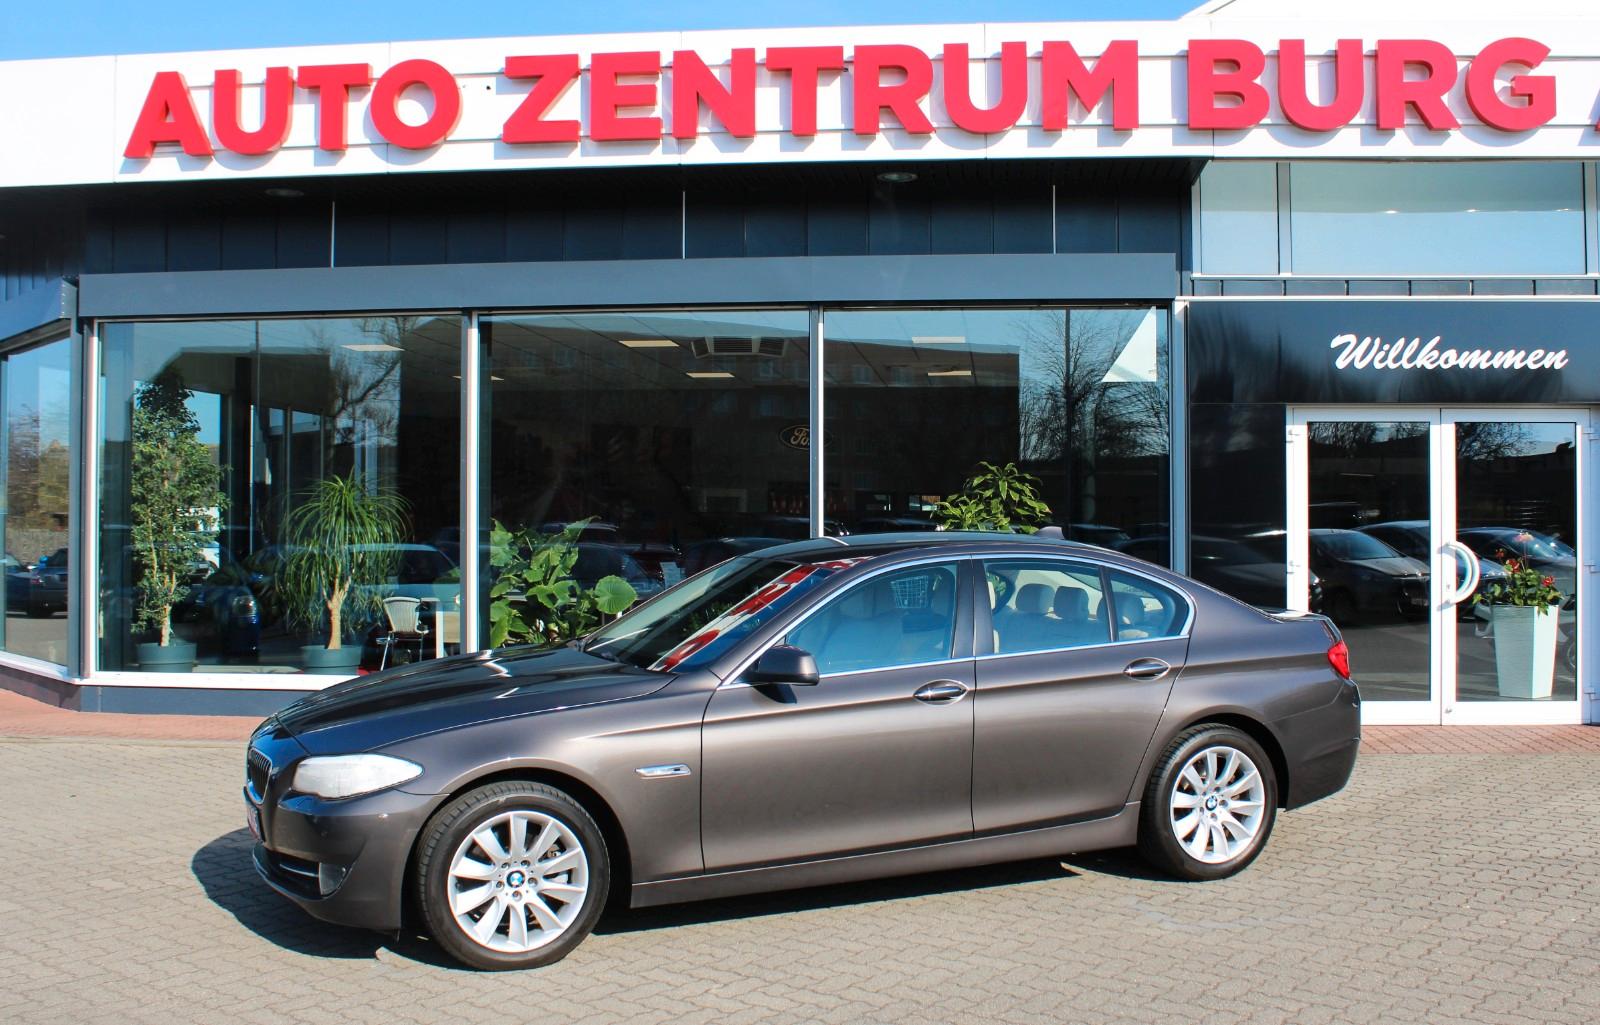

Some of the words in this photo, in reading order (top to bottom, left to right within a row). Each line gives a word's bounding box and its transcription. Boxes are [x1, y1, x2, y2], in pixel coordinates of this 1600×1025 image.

[124, 59, 462, 159] AUTO
[501, 40, 1140, 144] ZENTRUM
[1187, 37, 1557, 132] BURG
[1330, 333, 1569, 370] Willkommen
